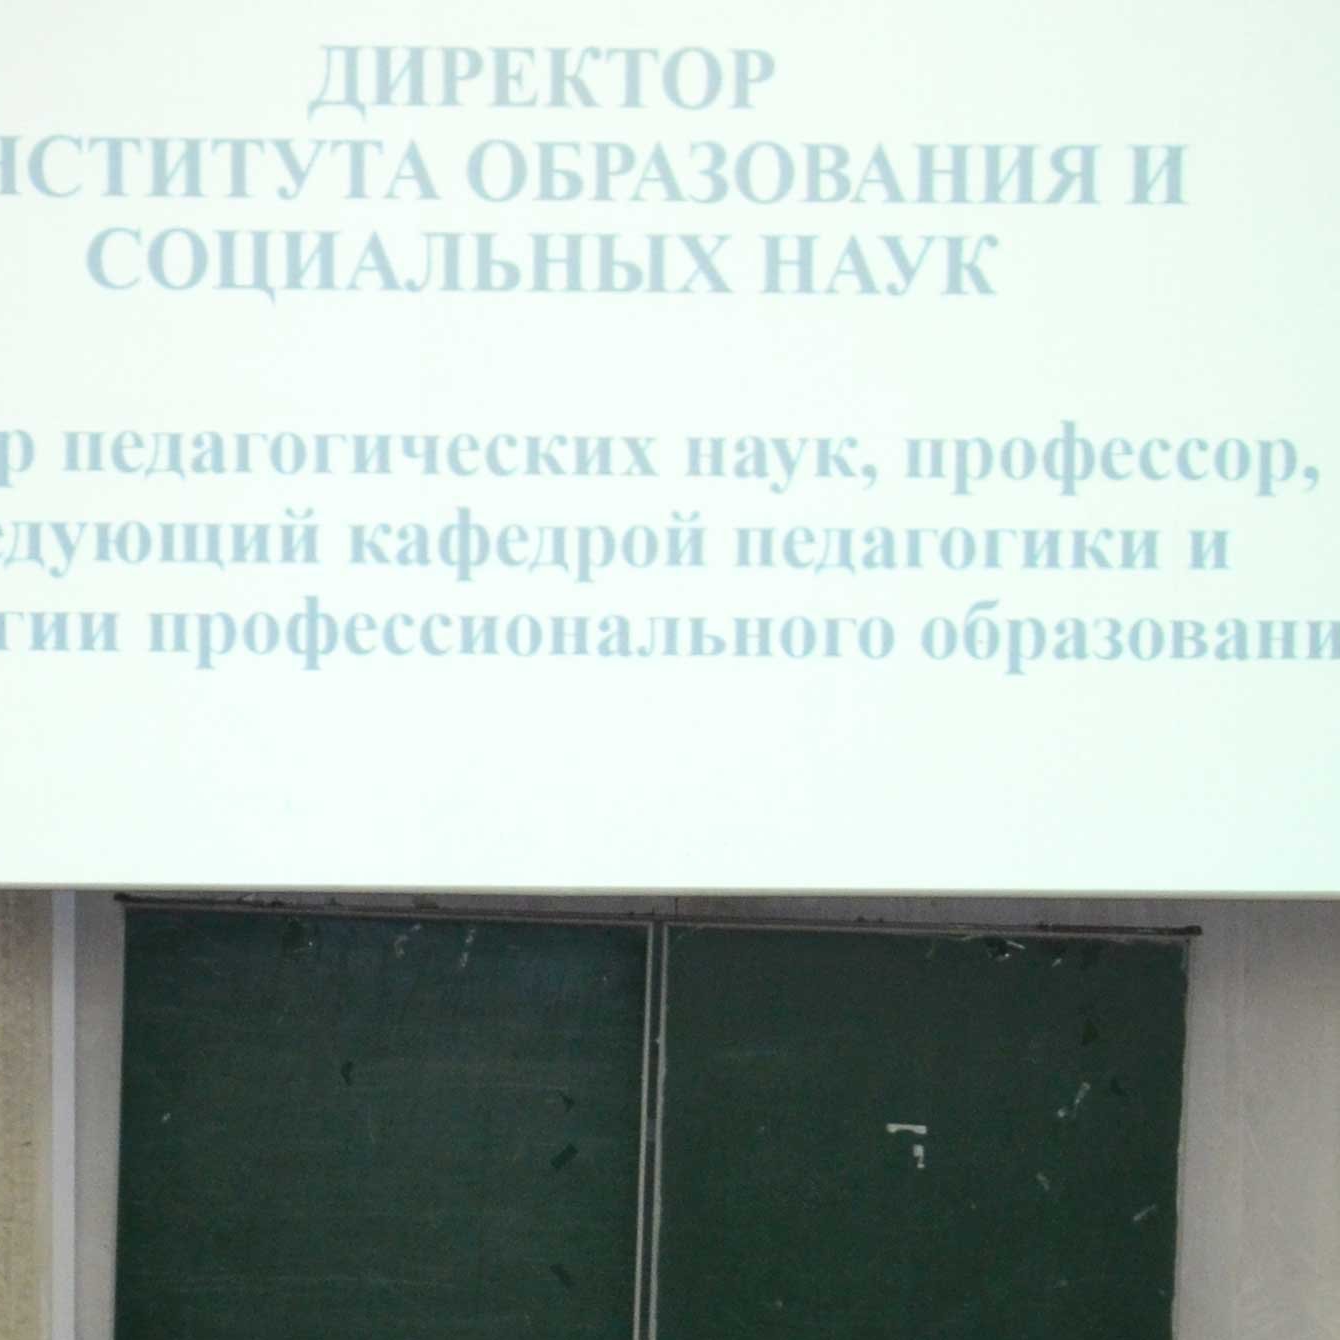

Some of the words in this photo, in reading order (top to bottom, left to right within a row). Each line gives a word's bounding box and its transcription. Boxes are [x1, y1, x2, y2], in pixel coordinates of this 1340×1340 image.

[308, 46, 776, 118] ДИРЕКТОР
[467, 138, 1100, 205] ОБРАЗОВАНИЯ
[1131, 144, 1187, 205] И
[86, 227, 732, 301] СОЦИАЛЬНЫХ
[761, 233, 1000, 297] НАУК
[64, 431, 657, 481] педагогических
[687, 434, 878, 494] наук,
[906, 420, 1320, 499] профессор,
[349, 506, 705, 583] кафедрой
[736, 526, 1159, 577] педагогики
[1189, 528, 1230, 571] и
[149, 596, 896, 673] профессионального
